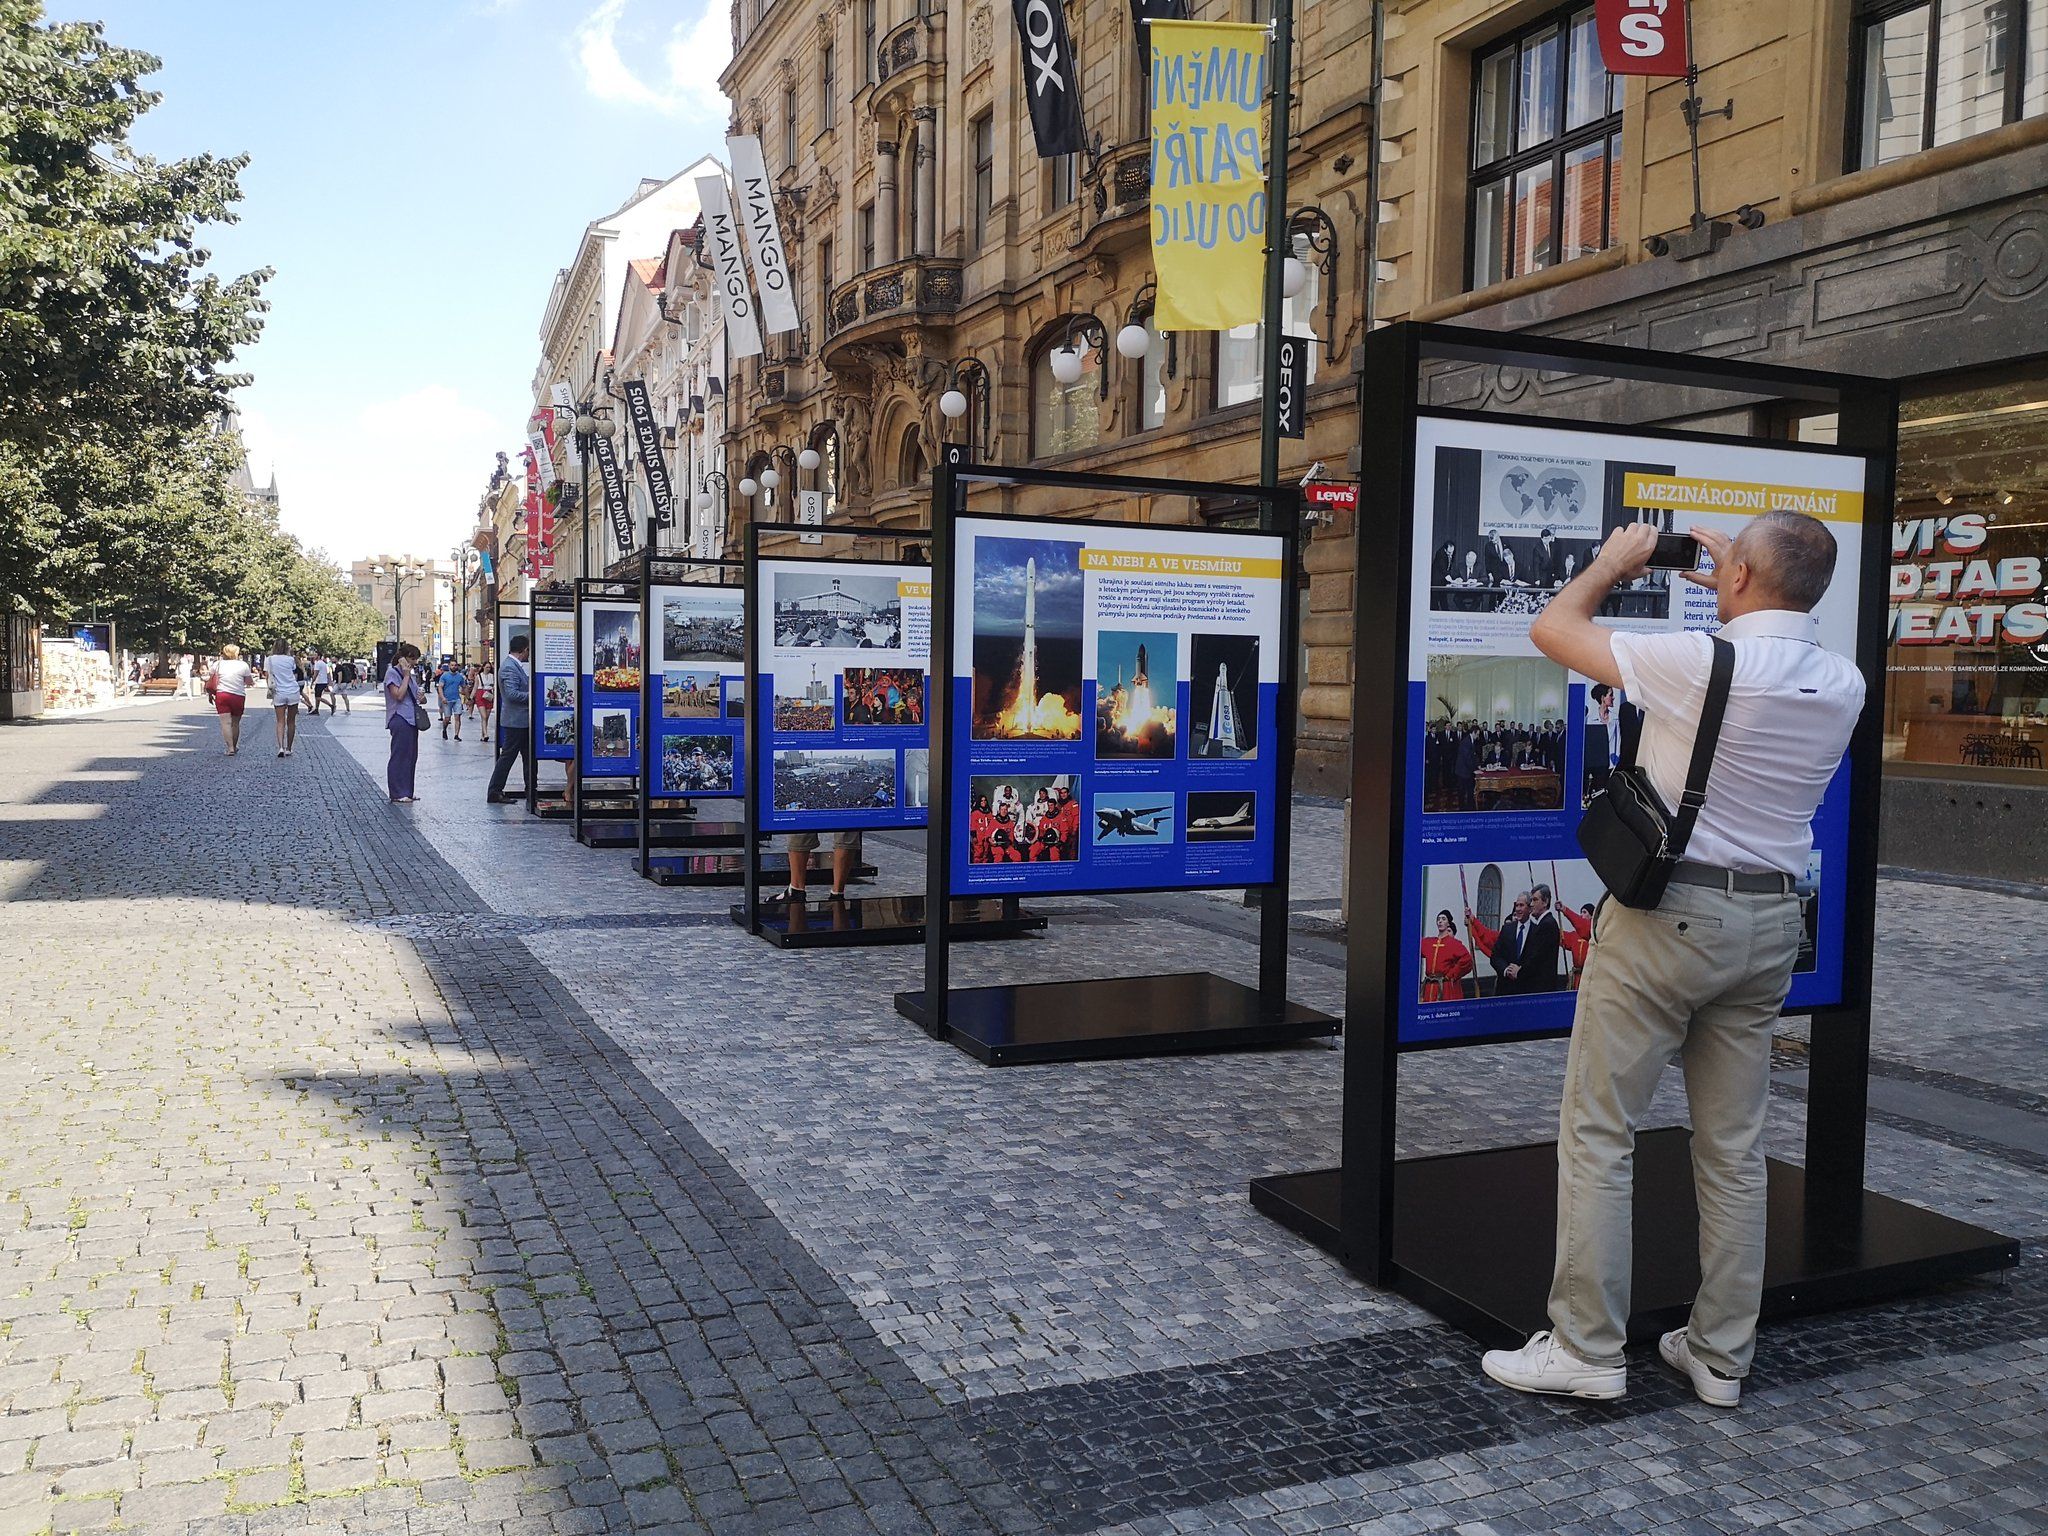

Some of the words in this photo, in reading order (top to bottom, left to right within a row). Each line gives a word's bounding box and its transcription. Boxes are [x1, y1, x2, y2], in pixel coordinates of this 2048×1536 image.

[745, 177, 784, 291] MANGO
[712, 214, 748, 319] MANGO
[629, 387, 652, 420] 1905
[1279, 342, 1294, 433] GEOX
[639, 425, 660, 468] SINCE
[1520, 455, 1544, 463] TOGETHER
[603, 463, 621, 500] SINCE
[650, 470, 672, 522] CASINO
[1637, 482, 1766, 509] MEZINÁRODNÍ
[1771, 491, 1837, 514] UZNÁNÍ
[613, 501, 631, 545] CASINO
[1088, 554, 1109, 566] NA
[1112, 555, 1145, 568] NEBI
[1148, 557, 1158, 569] A
[1161, 558, 1179, 570] VE
[1182, 558, 1242, 573] VESMÍRU
[905, 585, 919, 594] VE
[1098, 578, 1123, 586] Ukrajina
[1103, 586, 1128, 594] leteckým
[1186, 590, 1208, 598] schopny
[1685, 586, 1703, 595] stala
[1163, 612, 1185, 620] podniky
[1684, 611, 1703, 620] která
